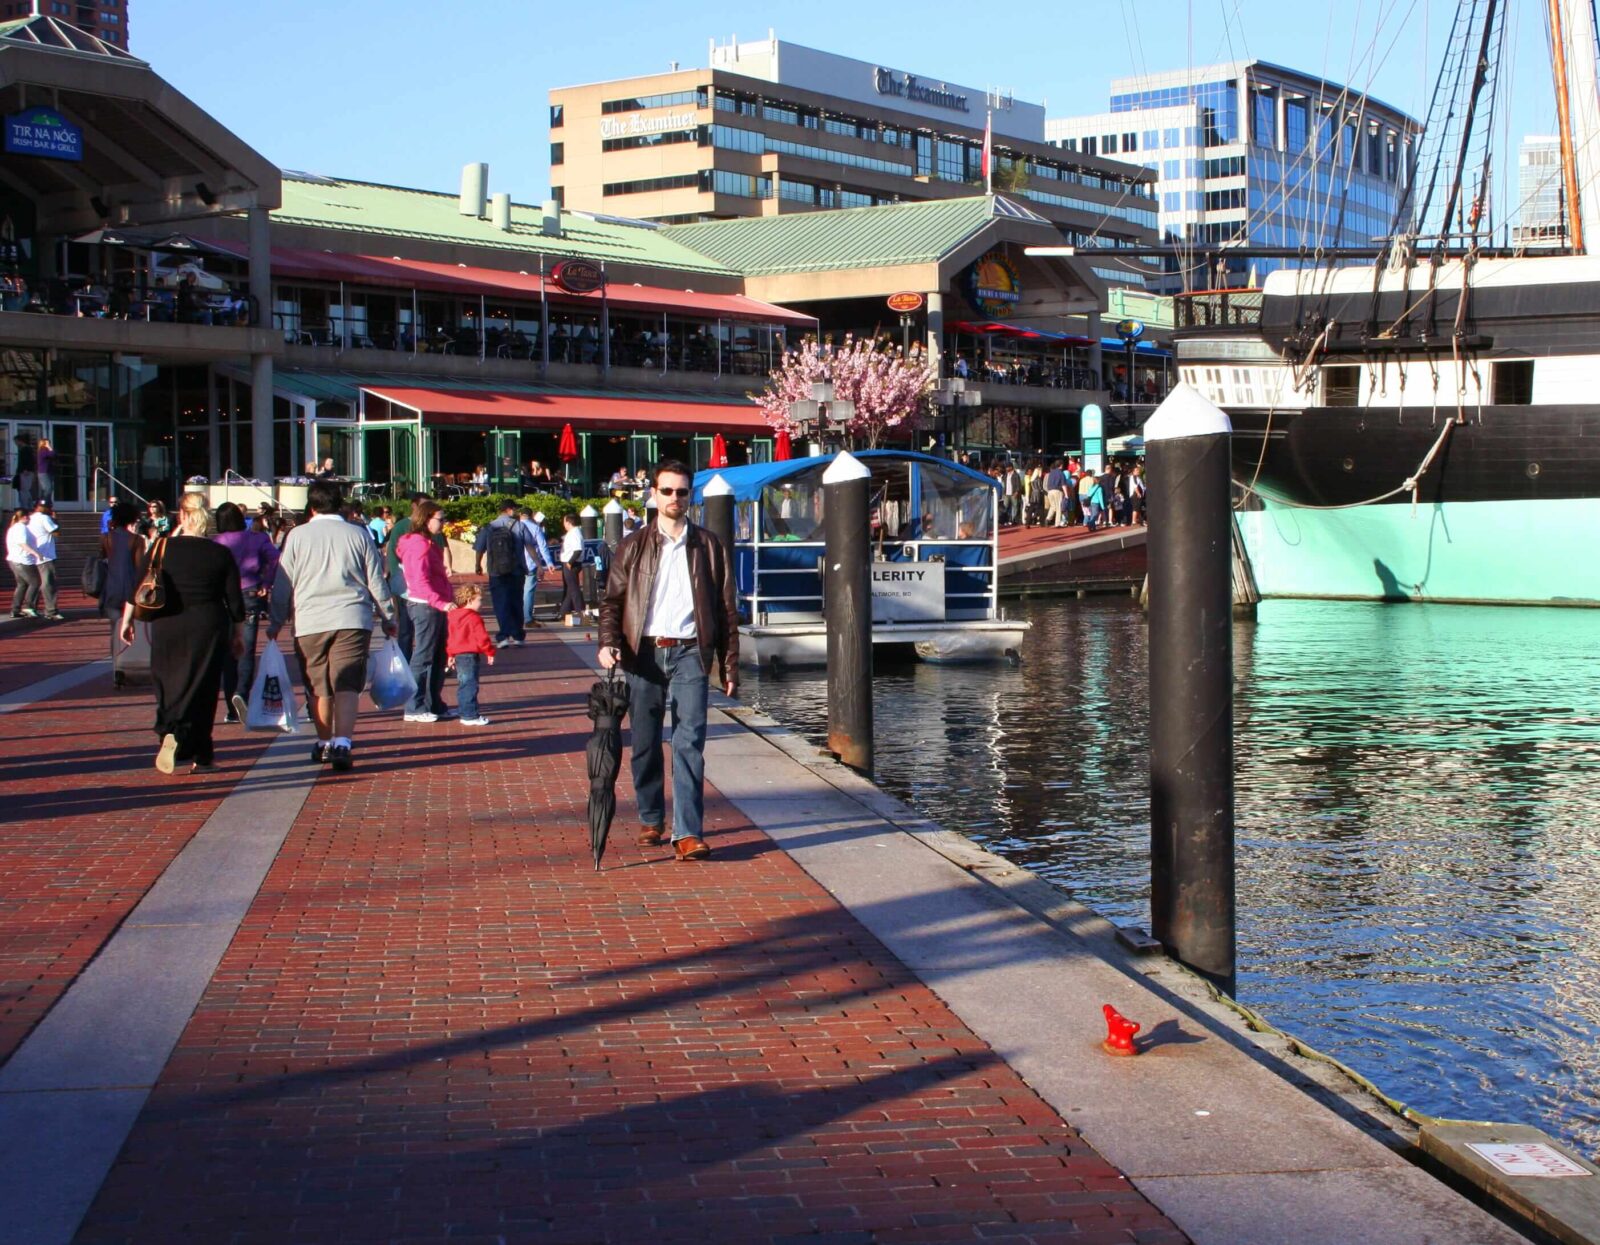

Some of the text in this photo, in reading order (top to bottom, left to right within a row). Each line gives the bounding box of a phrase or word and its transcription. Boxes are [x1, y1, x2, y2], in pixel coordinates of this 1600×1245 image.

[874, 66, 904, 97] The
[12, 124, 32, 138] TIR
[34, 127, 51, 140] NA
[600, 116, 627, 139] The
[12, 137, 33, 147] IRISH
[34, 140, 50, 149] BAR
[57, 144, 76, 153] GRILL
[1493, 1152, 1526, 1164] NO
